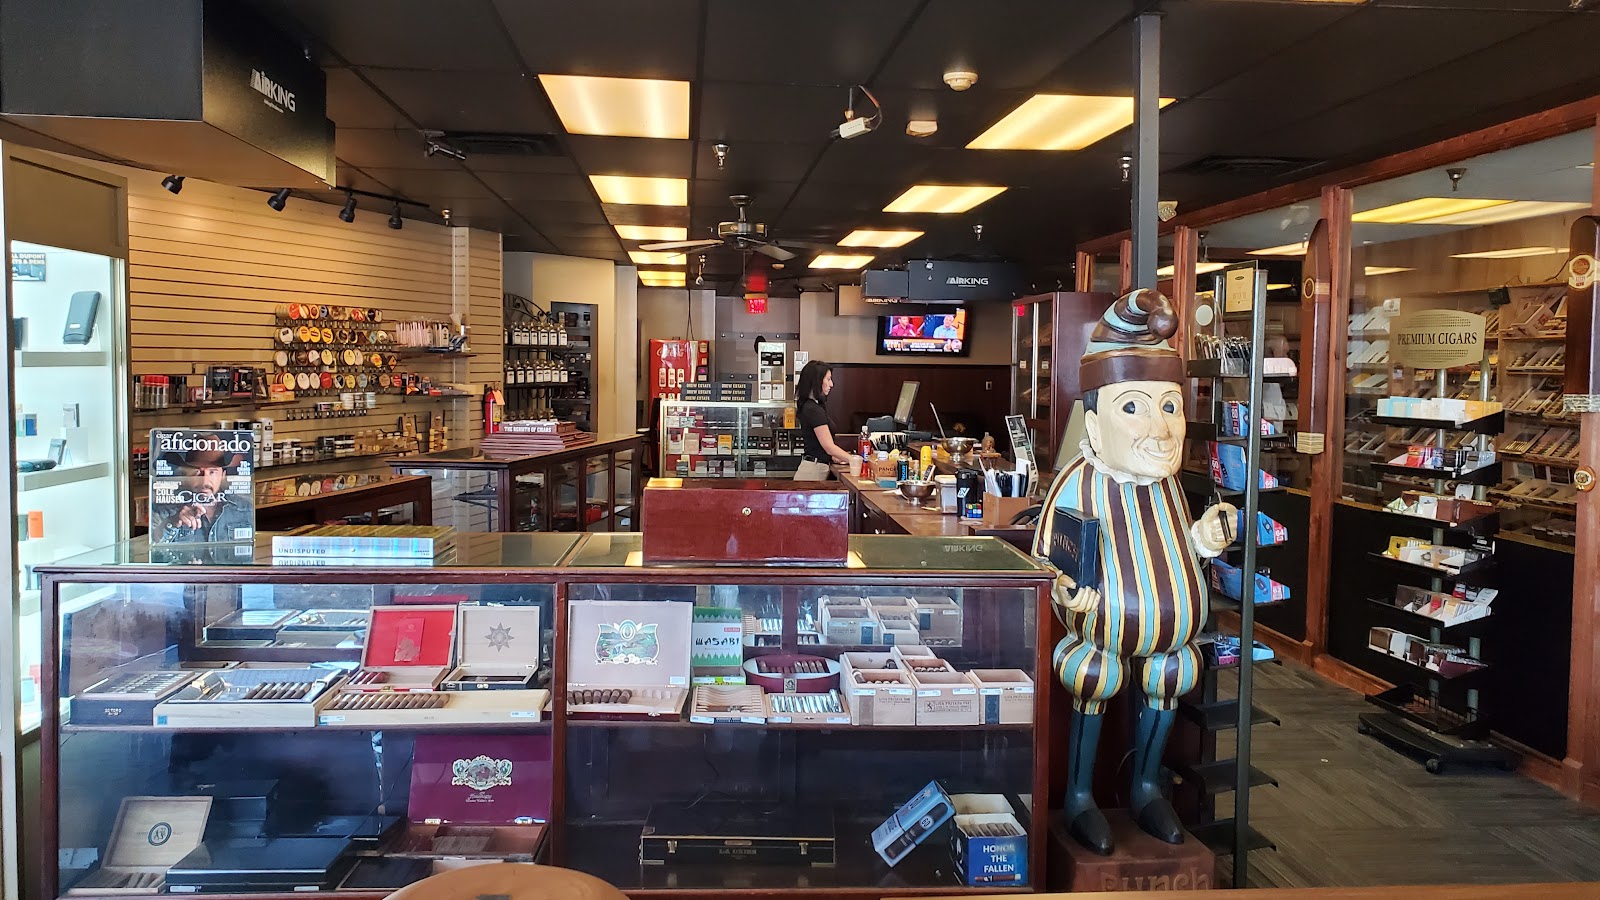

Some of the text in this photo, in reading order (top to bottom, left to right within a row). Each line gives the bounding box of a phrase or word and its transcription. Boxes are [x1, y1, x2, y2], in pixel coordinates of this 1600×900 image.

[1397, 332, 1478, 345] PREMIUM CIGARS
[160, 432, 251, 452] aficionado
[178, 491, 227, 503] CIGAR
[695, 636, 740, 646] WASABI
[983, 844, 1016, 853] HONOR
[991, 854, 1008, 862] THE
[983, 863, 1015, 873] FALLEN
